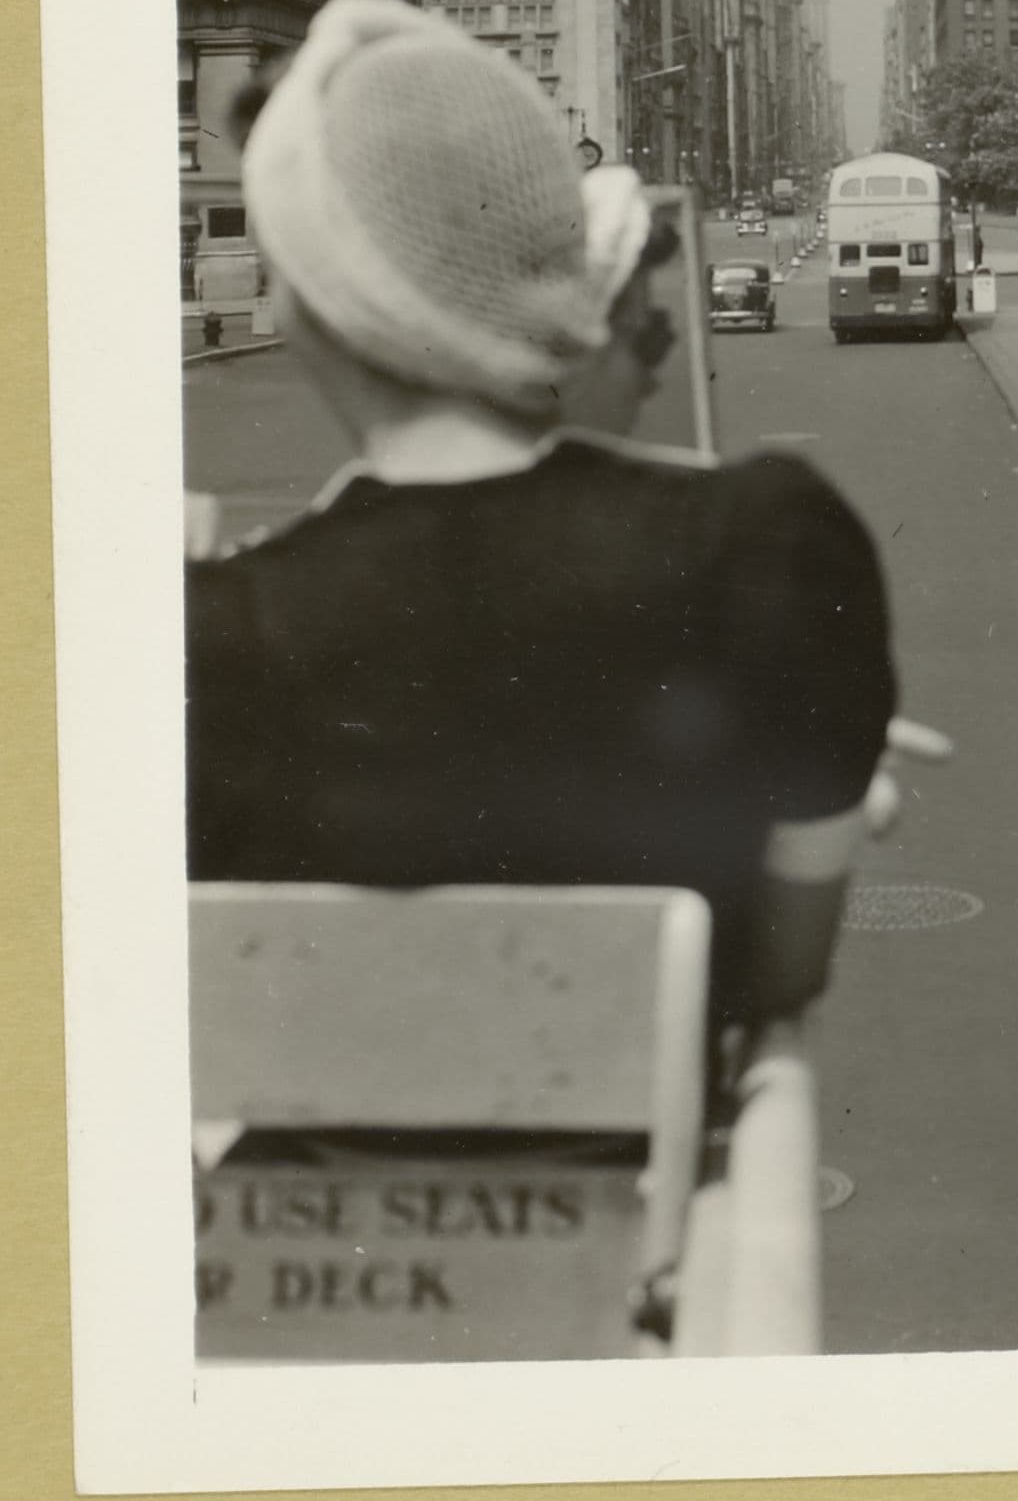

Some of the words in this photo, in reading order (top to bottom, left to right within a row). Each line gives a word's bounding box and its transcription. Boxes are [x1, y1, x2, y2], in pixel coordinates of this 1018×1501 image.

[239, 1181, 352, 1239] USE
[378, 1181, 586, 1239] SEATS
[271, 1259, 451, 1312] DECK
